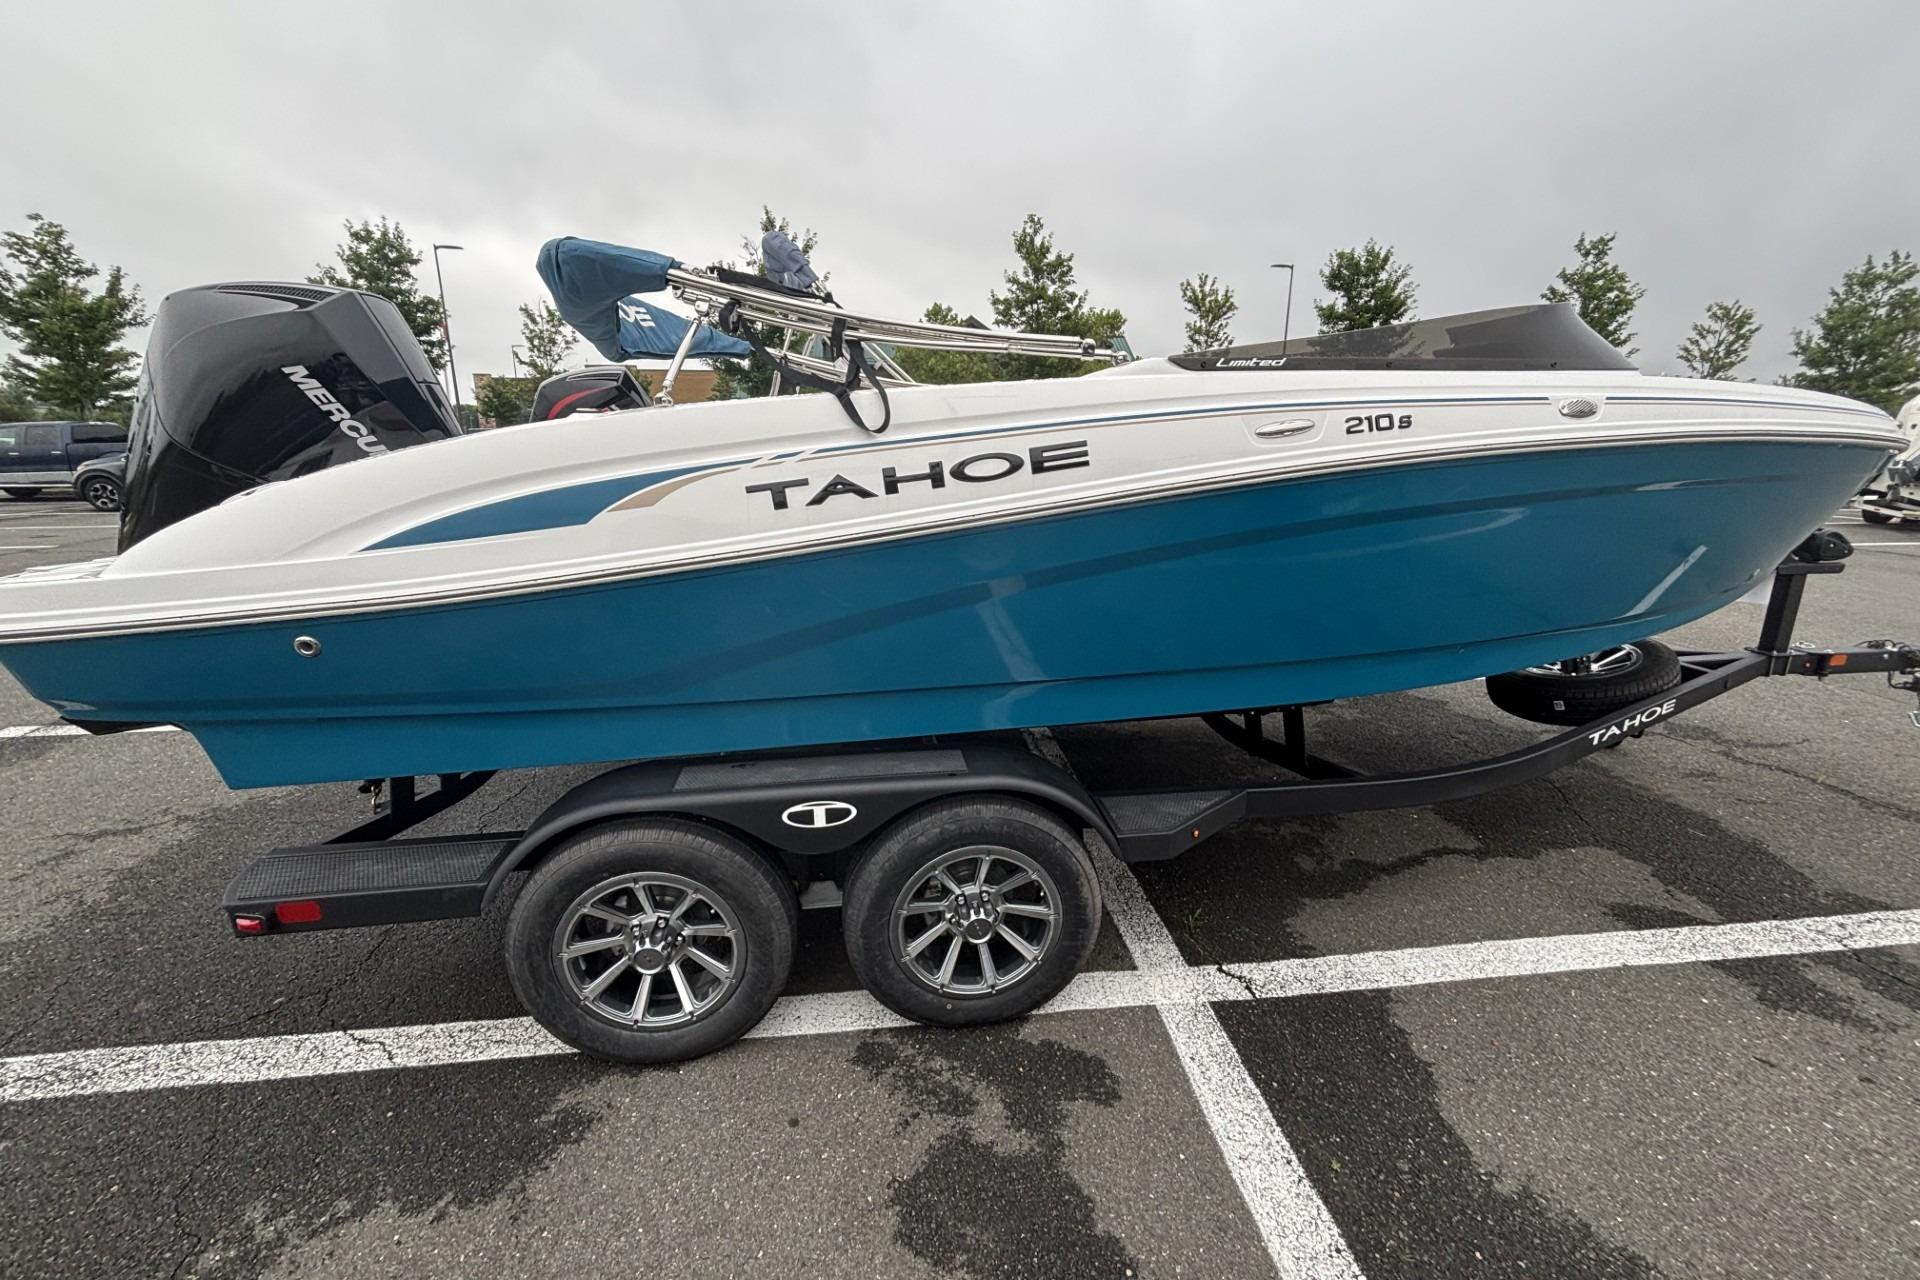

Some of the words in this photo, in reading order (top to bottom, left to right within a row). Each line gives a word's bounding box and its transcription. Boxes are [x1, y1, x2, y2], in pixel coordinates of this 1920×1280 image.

[1216, 357, 1287, 368] Limited
[281, 365, 391, 457] MERCU
[745, 440, 1090, 510] TAHOE
[1589, 699, 1677, 746] TAHOE
